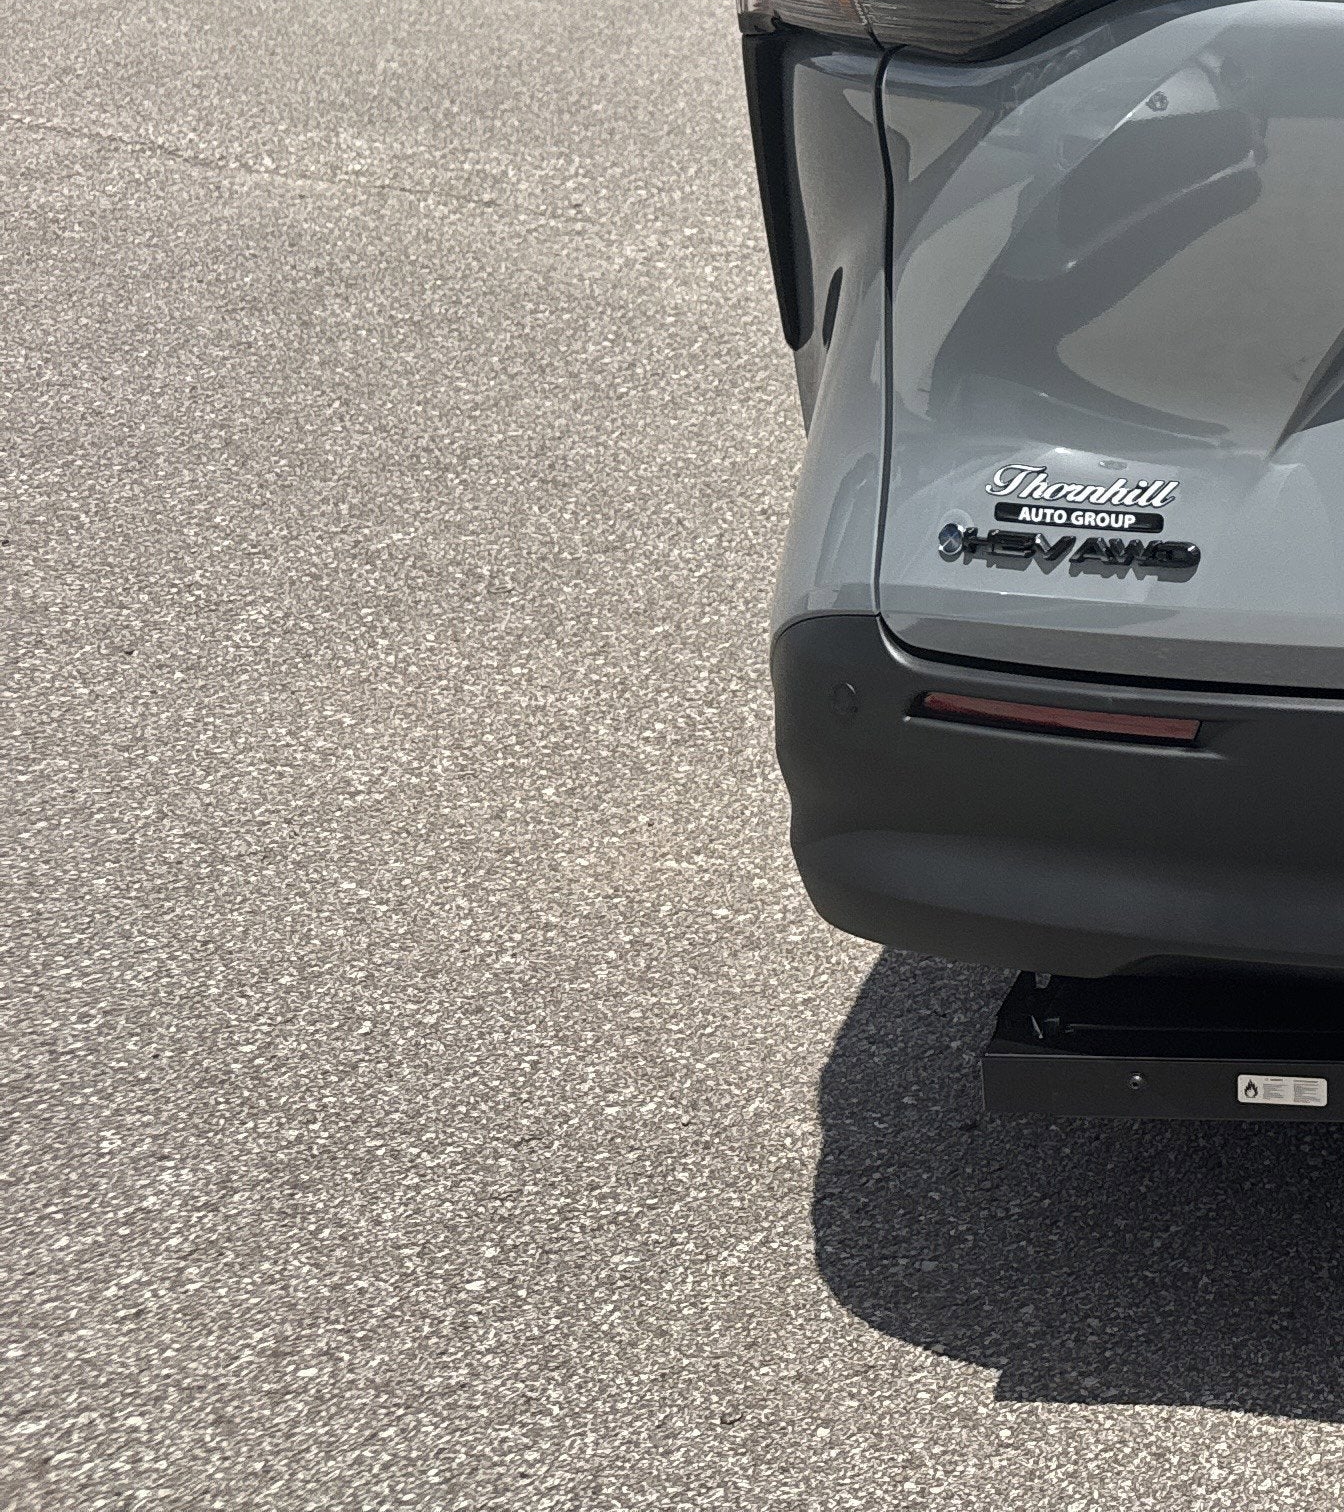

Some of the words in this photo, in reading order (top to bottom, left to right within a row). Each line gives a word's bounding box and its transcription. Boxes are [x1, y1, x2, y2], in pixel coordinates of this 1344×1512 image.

[984, 463, 1181, 508] Thornhill
[1018, 506, 1067, 525] AUTO
[1069, 510, 1136, 529] GROUP
[1068, 537, 1202, 569] AWD
